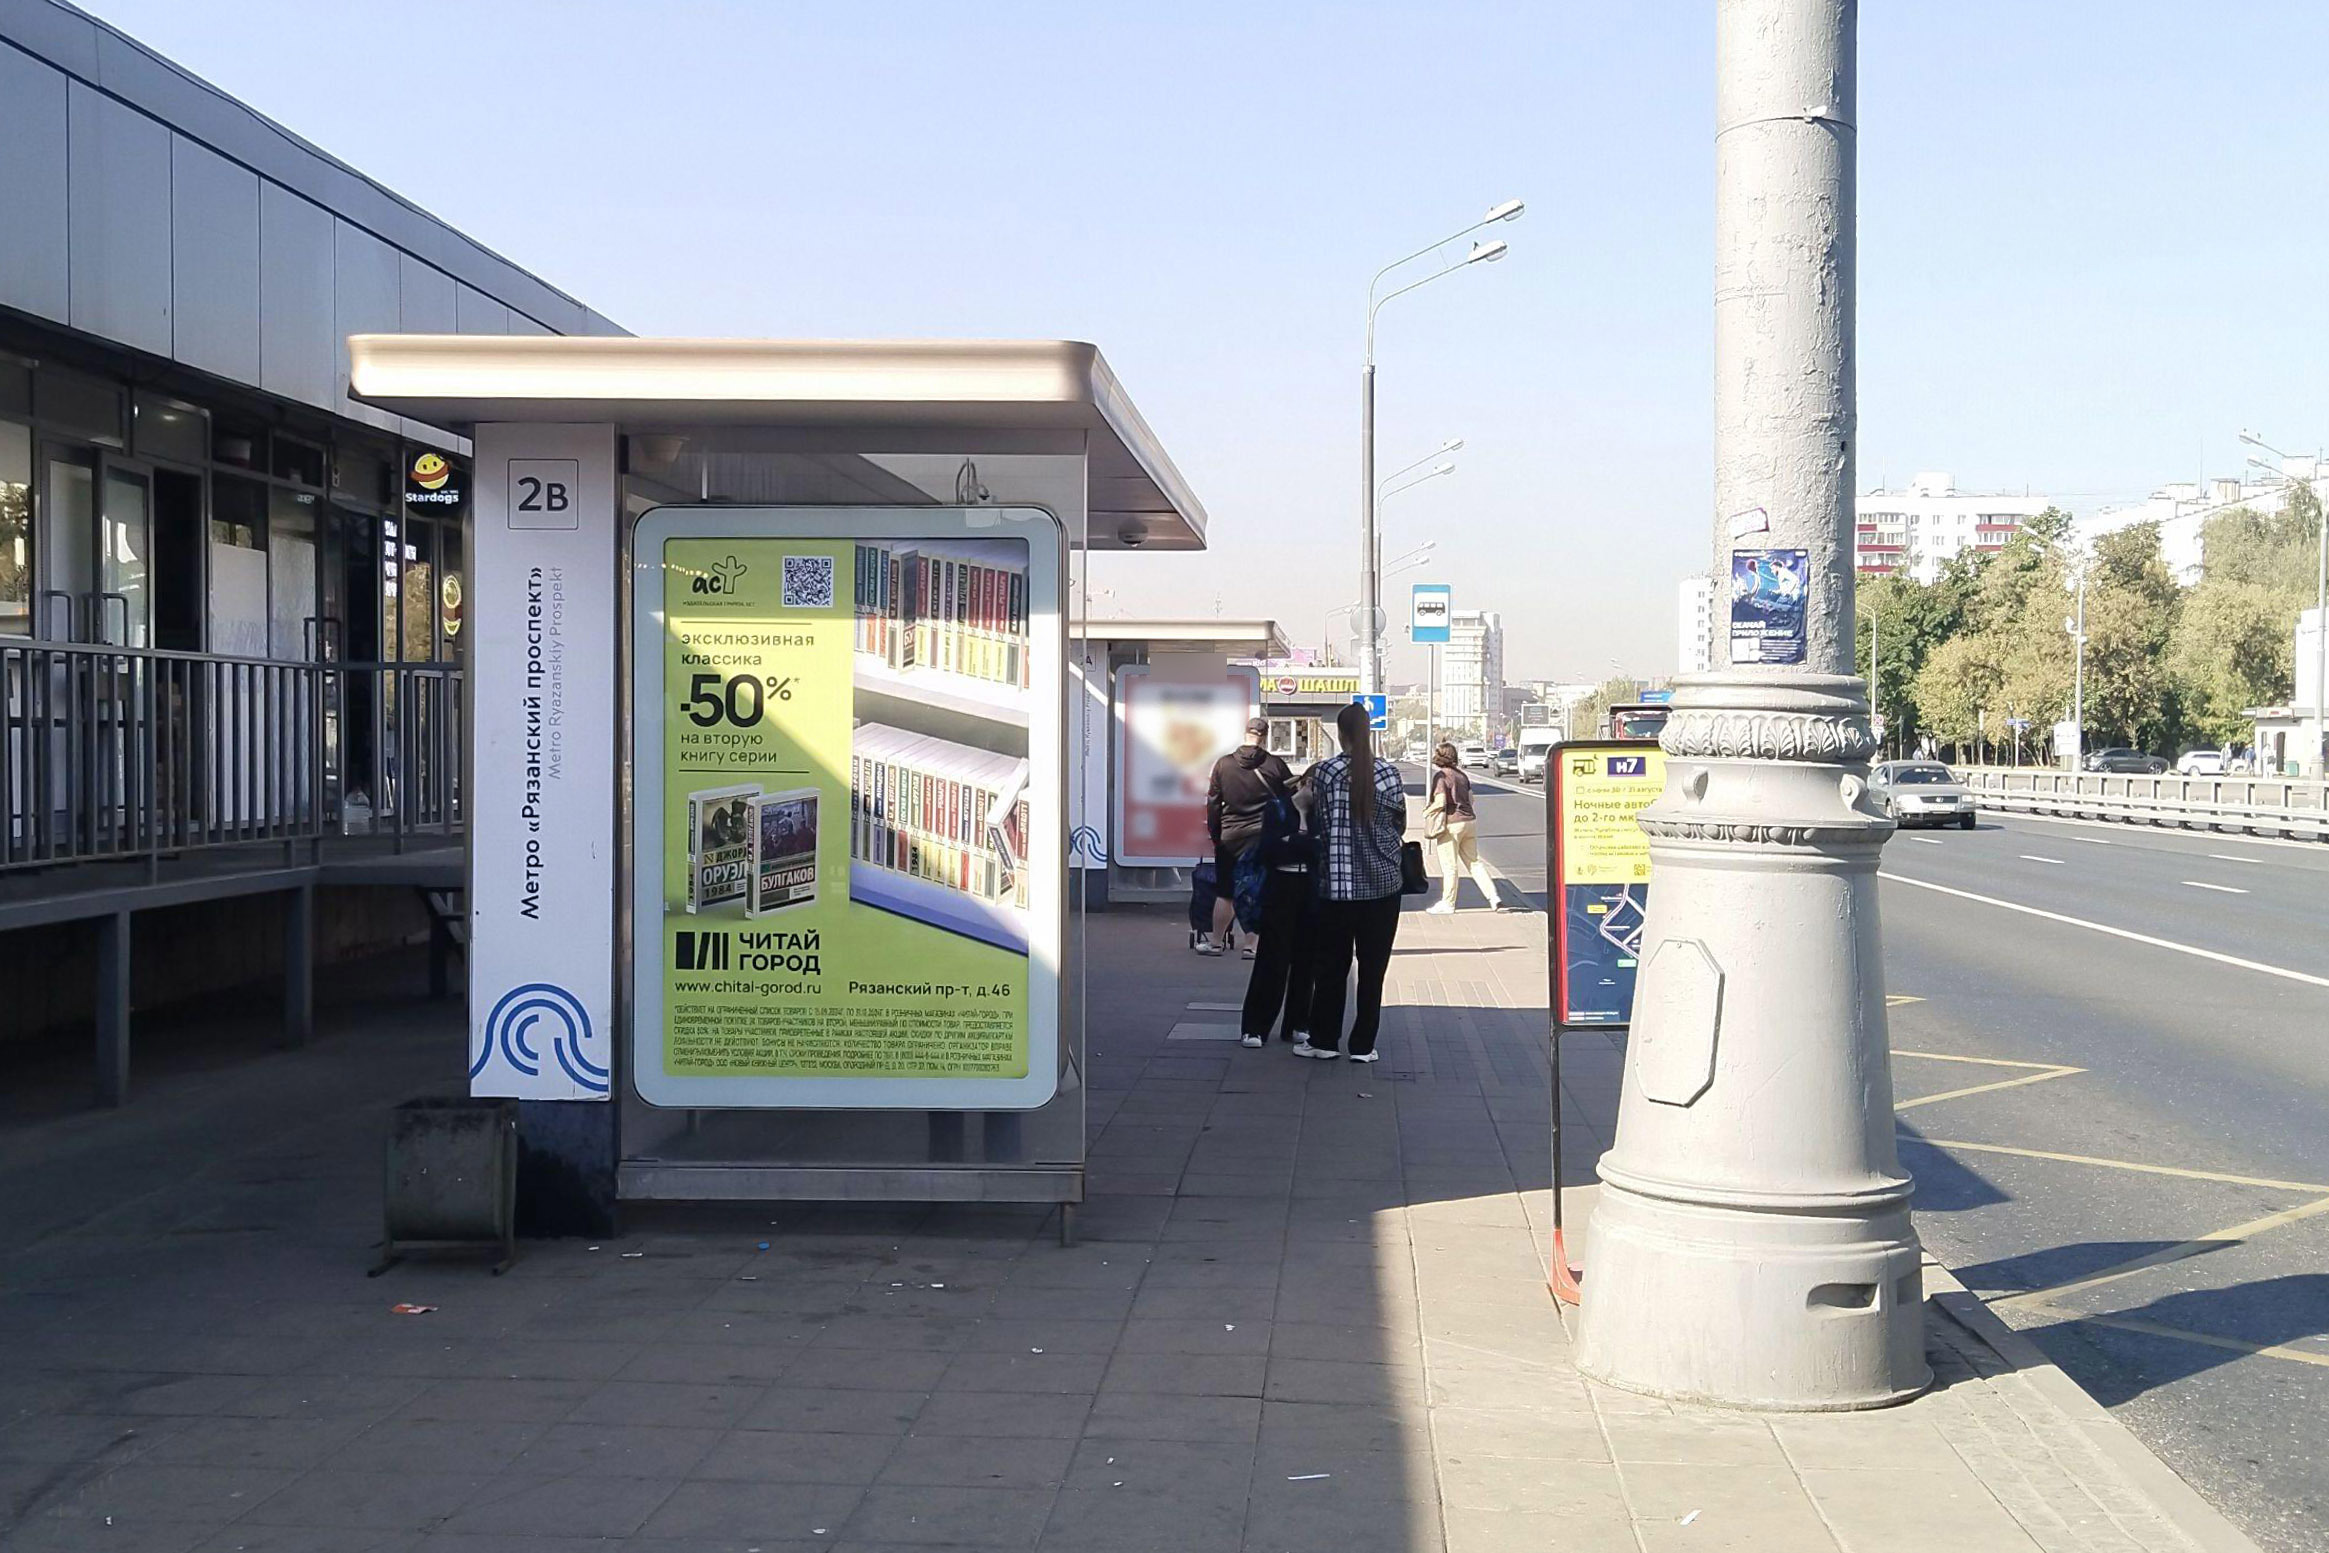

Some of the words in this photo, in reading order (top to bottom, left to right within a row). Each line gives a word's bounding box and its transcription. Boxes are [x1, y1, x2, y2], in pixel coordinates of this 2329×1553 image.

[404, 491, 460, 505] Stardogs
[548, 567, 566, 636] Prospekt
[527, 567, 546, 689] проспект»
[681, 633, 815, 647] эксклюзивная
[681, 653, 762, 666] классика
[681, 733, 700, 745] на
[703, 733, 764, 749] вторую
[521, 696, 542, 833] «Рязанский
[548, 732, 562, 780] Metro
[681, 751, 725, 766] книгу
[729, 751, 778, 766] серии
[1574, 799, 1622, 810] Ночные
[1574, 814, 1589, 824] до
[1591, 812, 1616, 823] 2-го
[520, 839, 545, 920] Метро
[760, 867, 815, 891] БУЛГАКОВ
[705, 883, 733, 898] 1984
[739, 928, 821, 951] ЧИТАЙ
[739, 953, 822, 976] ГОРОД
[849, 981, 932, 995] Рязанский
[935, 984, 973, 999] пр-т,
